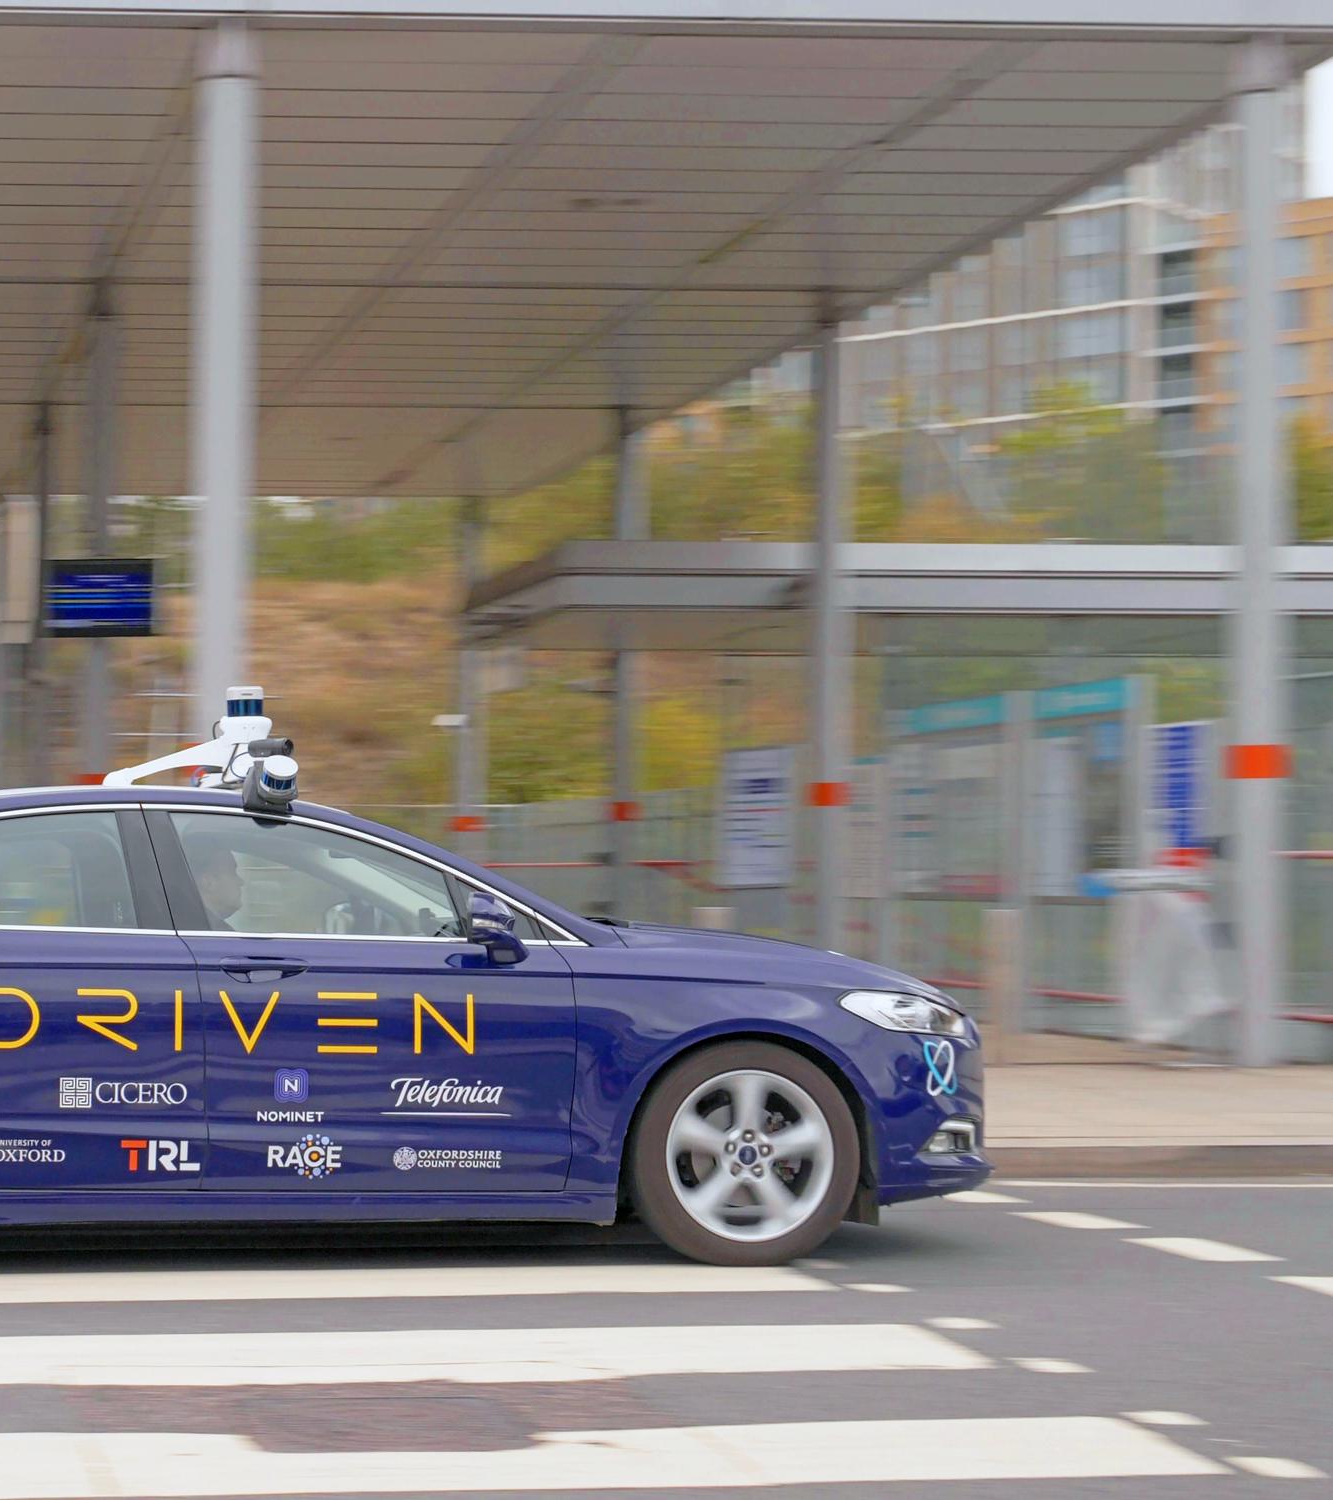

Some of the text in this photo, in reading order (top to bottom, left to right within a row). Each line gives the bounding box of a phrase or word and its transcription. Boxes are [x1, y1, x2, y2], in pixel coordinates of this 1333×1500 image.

[95, 1082, 188, 1105] CICERO
[256, 1111, 325, 1123] NOMINET
[41, 1139, 52, 1147] OF
[120, 1139, 201, 1172] TRL
[267, 1145, 343, 1168] RACE
[418, 1150, 502, 1160] OXFORDSHIRE
[417, 1160, 502, 1169] COUNTY COUNCIL
